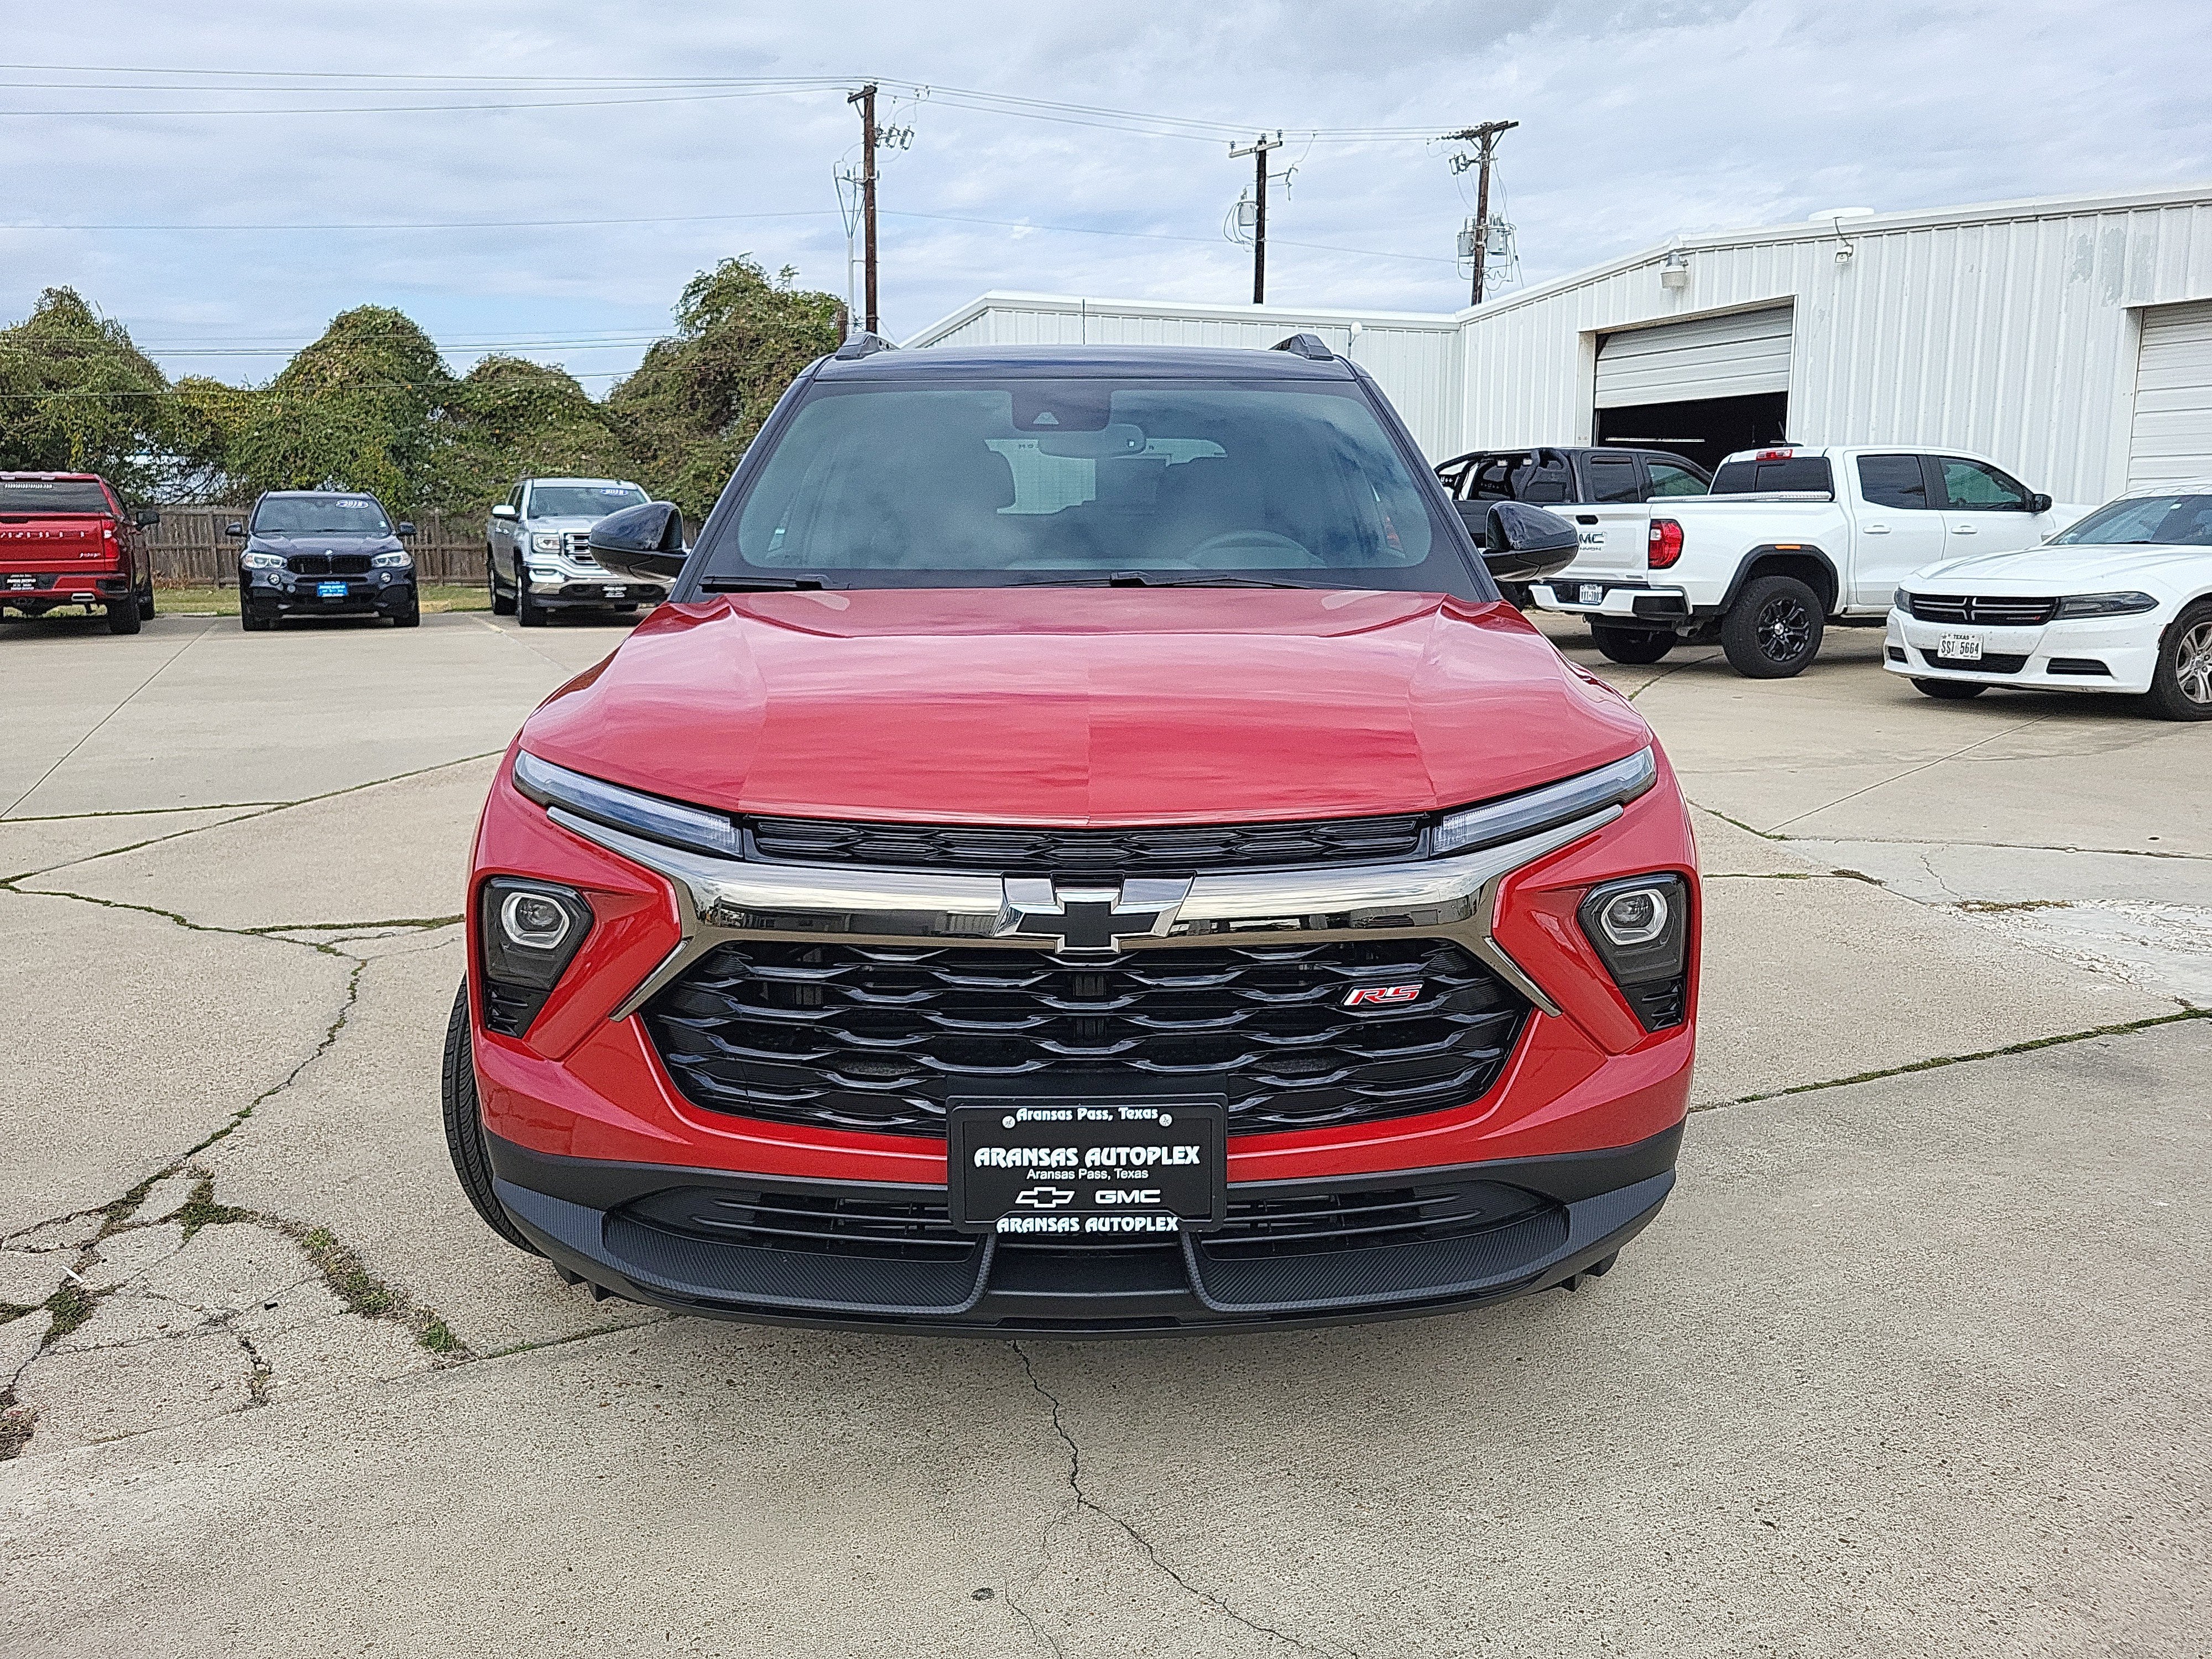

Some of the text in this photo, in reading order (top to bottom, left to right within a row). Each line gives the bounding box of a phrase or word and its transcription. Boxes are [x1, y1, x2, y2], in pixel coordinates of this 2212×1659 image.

[1579, 533, 1604, 544] MC
[1941, 640, 1980, 655] SST 5664
[1343, 984, 1423, 1005] RS
[1016, 1107, 1159, 1121] Aransas Pass, Texas
[974, 1146, 1201, 1168] ARANSAS AUTOPLEX
[1026, 1168, 1149, 1181] Aransas Pass, Texas
[1095, 1190, 1161, 1204] GMC
[996, 1217, 1180, 1234] ARANSAS AUTOPLEX
